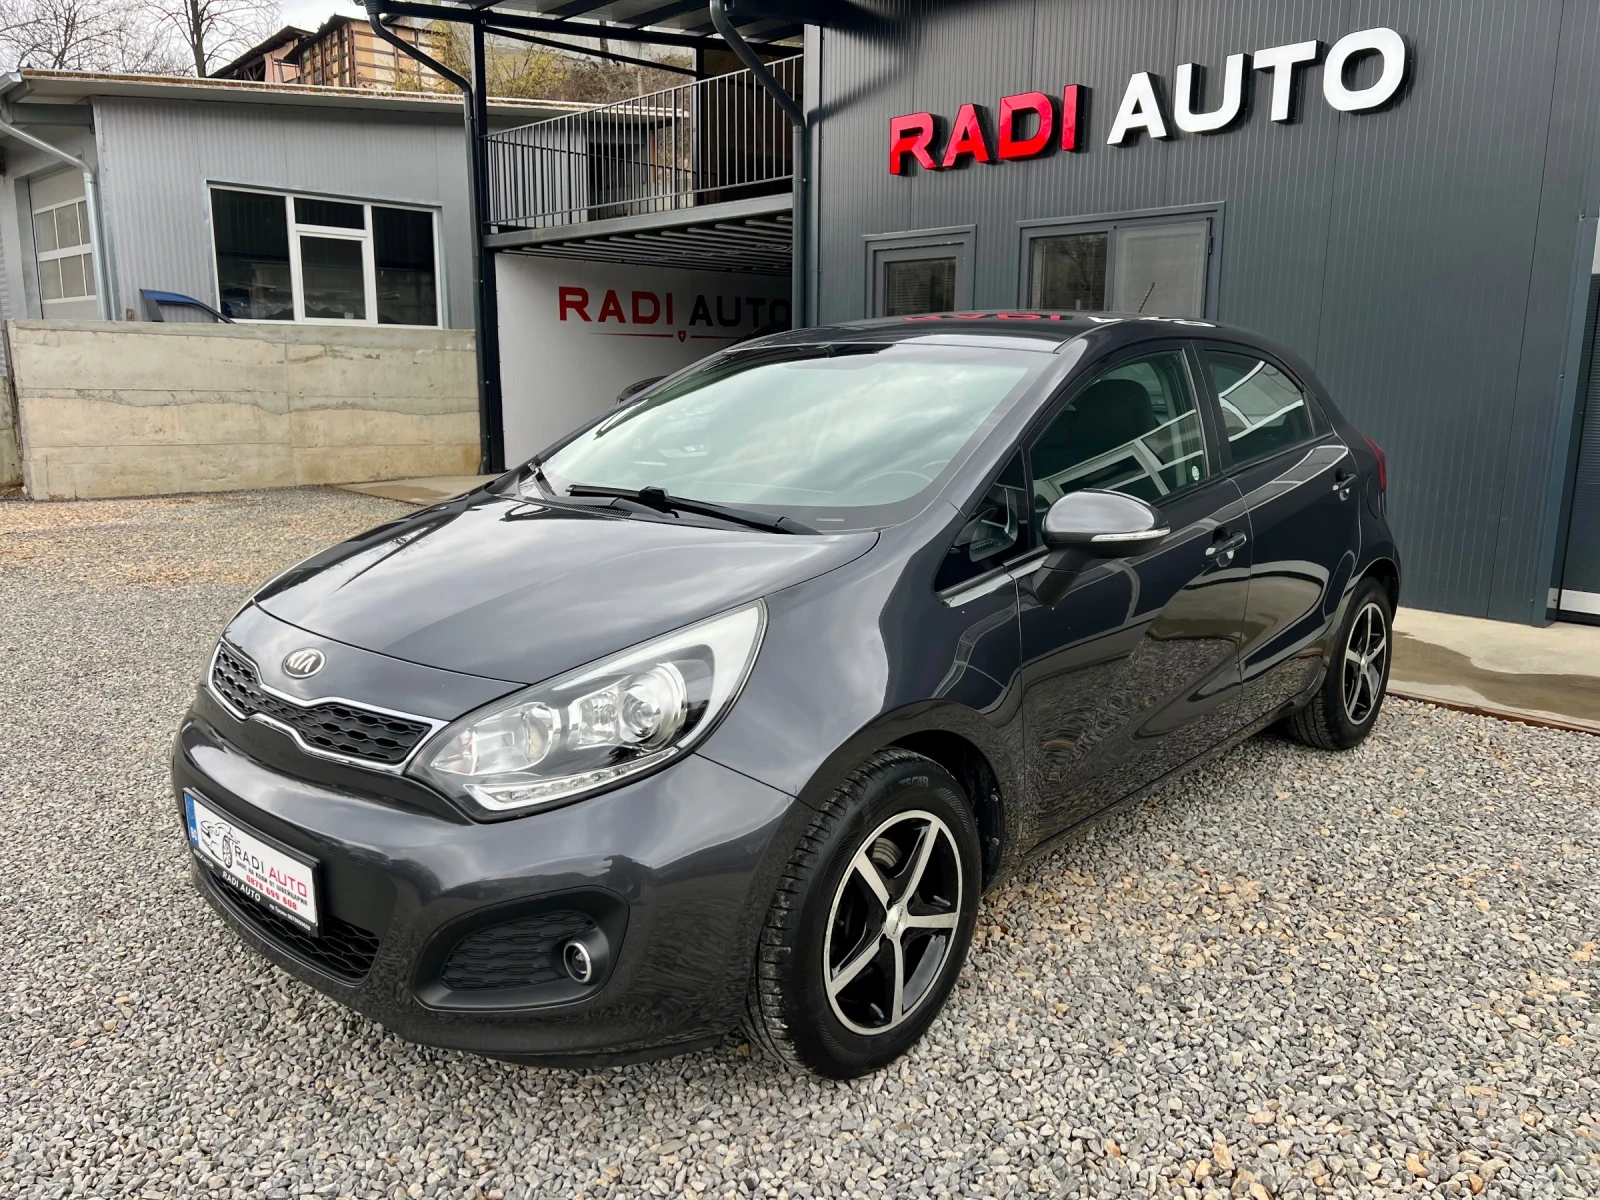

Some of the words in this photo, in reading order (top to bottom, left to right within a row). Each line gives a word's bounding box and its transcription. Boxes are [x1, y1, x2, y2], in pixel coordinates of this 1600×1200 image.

[889, 83, 1086, 176] RADI
[1106, 26, 1411, 148] AUTO
[558, 286, 673, 325] RADI
[688, 294, 793, 328] AUTO
[284, 647, 319, 674] KIA
[222, 870, 240, 888] RADI
[240, 882, 262, 903] AUTO
[234, 845, 265, 874] RADI
[268, 867, 308, 898] AUTO
